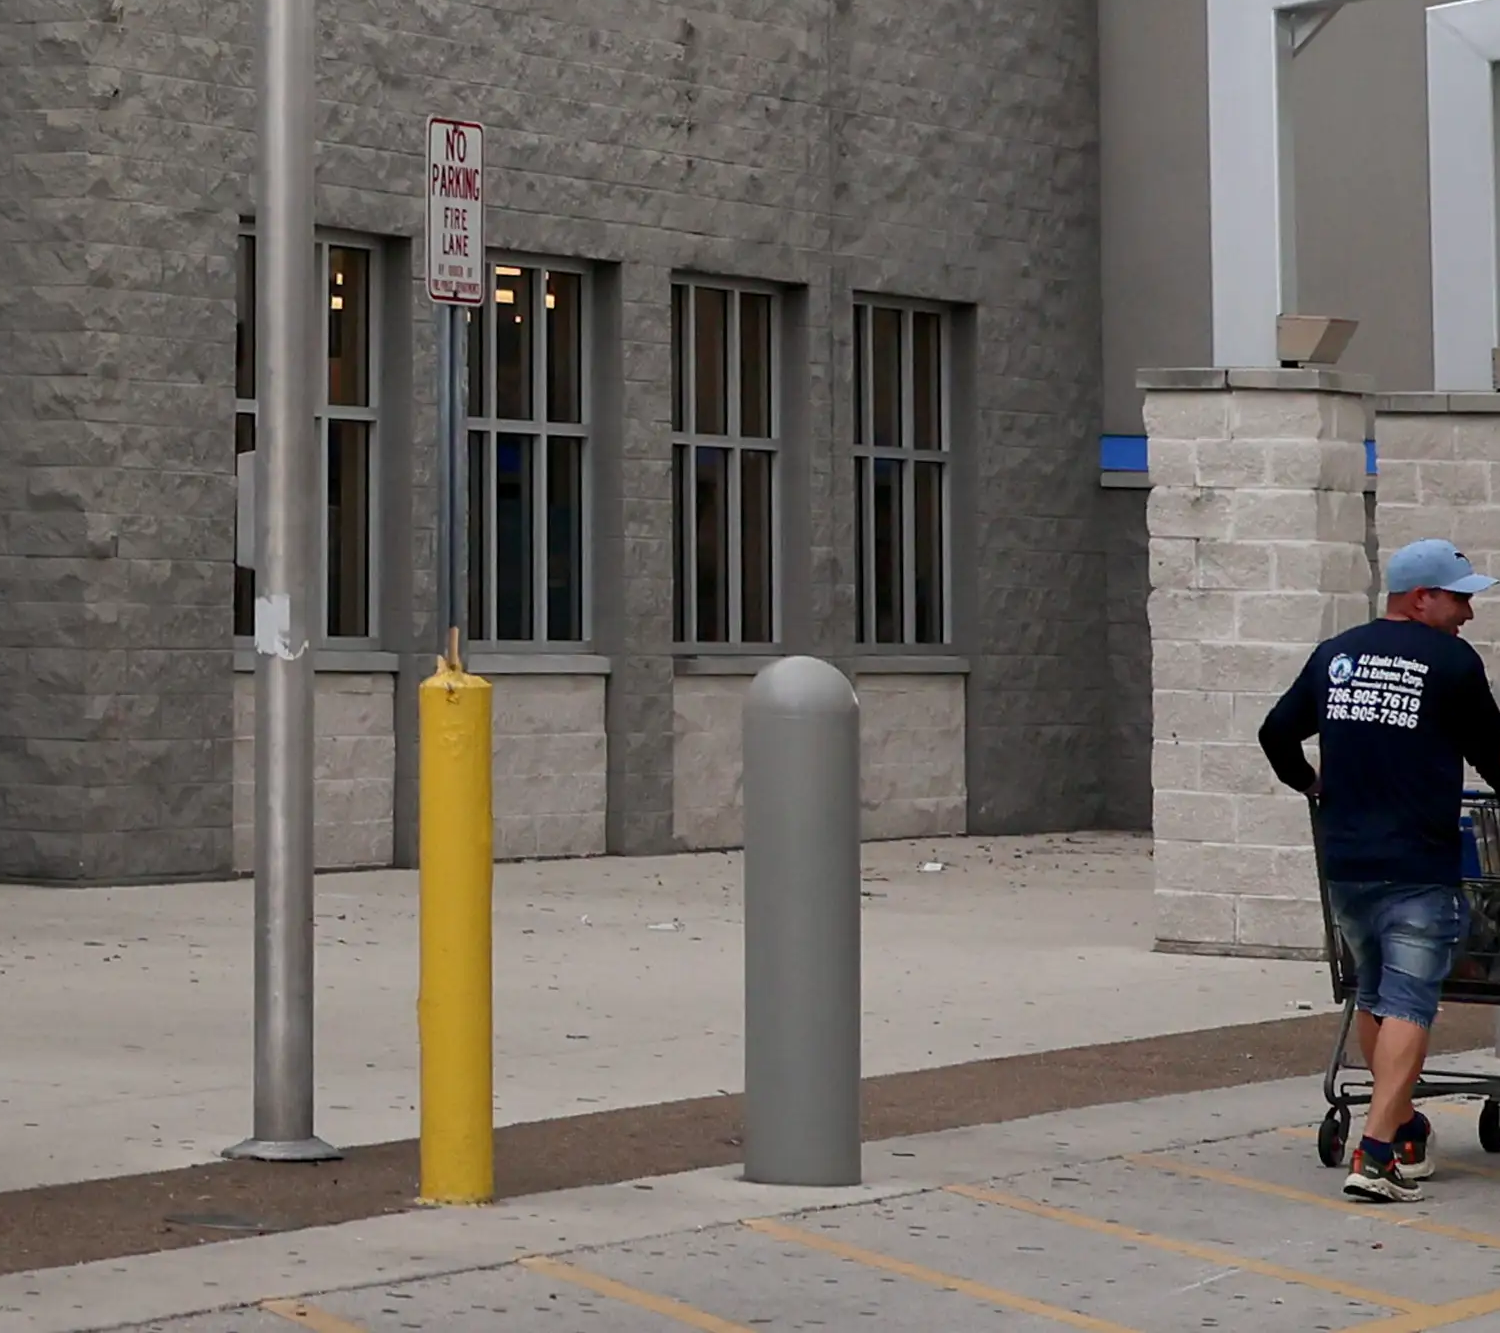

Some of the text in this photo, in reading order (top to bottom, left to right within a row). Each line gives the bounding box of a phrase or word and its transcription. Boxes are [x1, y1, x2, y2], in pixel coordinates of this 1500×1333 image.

[445, 128, 467, 163] NO
[431, 163, 480, 201] PARKING
[443, 206, 468, 231] FIRE
[442, 234, 469, 258] LANE
[1328, 687, 1421, 712] 786.905-7619
[1326, 704, 1420, 729] 786.905-7586
